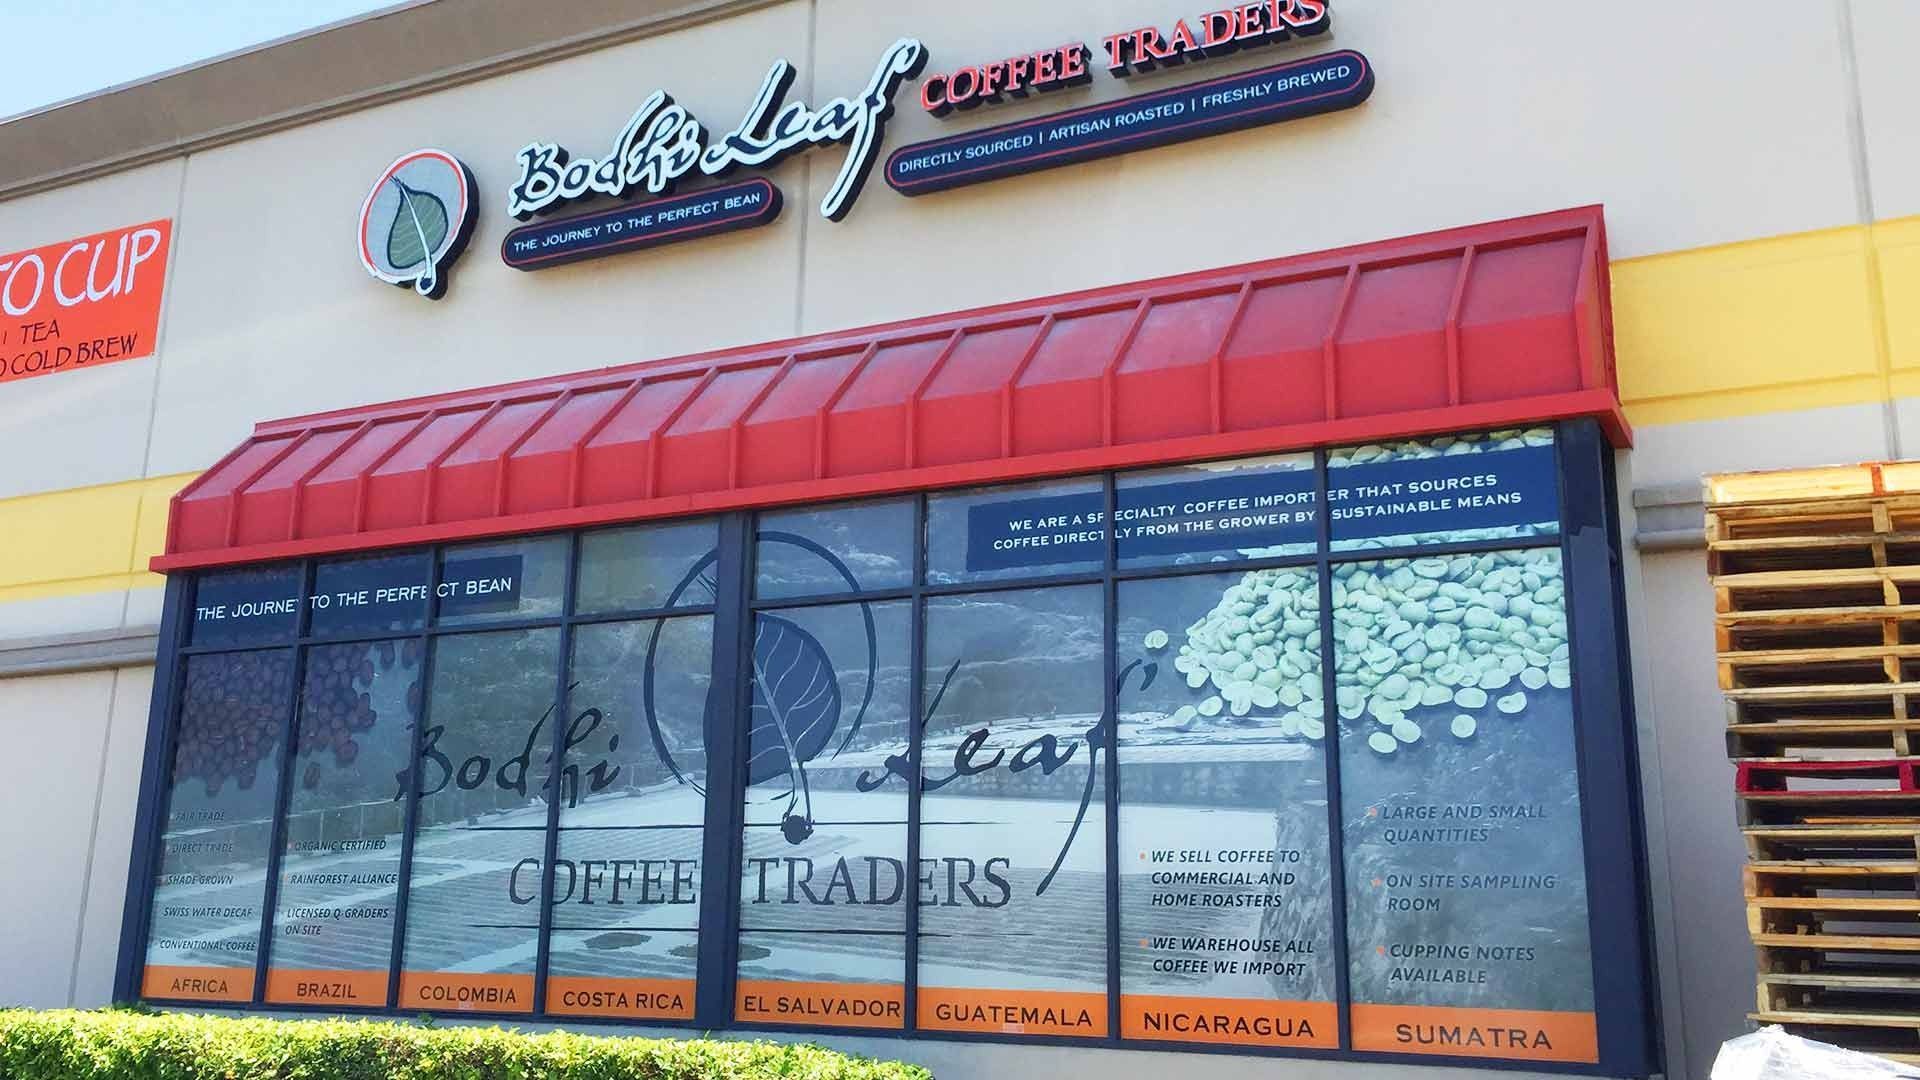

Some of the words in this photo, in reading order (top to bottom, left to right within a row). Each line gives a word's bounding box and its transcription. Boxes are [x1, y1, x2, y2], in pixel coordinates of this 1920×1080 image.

[920, 42, 1086, 111] COFFEE
[1104, 0, 1327, 70] TRADERS
[508, 89, 701, 217] Bodhi
[700, 37, 921, 217] Leaf
[899, 151, 963, 173] DIRECTLY
[965, 136, 1033, 159] SOURCED
[1049, 117, 1111, 141] ARTISAN
[1114, 102, 1185, 126] ROASTED
[1202, 82, 1273, 108] FRESHLY
[1277, 64, 1351, 91] BREWED
[514, 238, 537, 252] THE
[542, 226, 601, 248] JOURNEY
[606, 222, 623, 234] TO
[628, 216, 652, 229] THE
[658, 203, 719, 223] PERFECT
[725, 192, 761, 210] BEAN
[54, 228, 161, 306] CUP
[20, 319, 60, 345] TEA
[11, 347, 71, 375] COLD
[76, 333, 138, 363] BREW
[1009, 520, 1033, 531] WE
[1037, 516, 1067, 529] ARE
[1072, 515, 1083, 525] A
[1183, 497, 1249, 514] COFFEE
[1254, 488, 1349, 507] IMPORTER
[1356, 483, 1402, 498] THAT
[1408, 474, 1497, 493] SOURCES
[993, 535, 1050, 550] COFFEE
[1054, 525, 1132, 544] DIRECTLY
[1137, 522, 1179, 536] FROM
[1184, 519, 1214, 532] THE
[1219, 513, 1289, 529] GROWER
[1295, 510, 1315, 523] BY
[1331, 498, 1452, 519] SUSTAINABLE
[1458, 492, 1522, 508] MEANS
[197, 605, 226, 620] THE
[232, 598, 299, 618] JOURNE
[309, 594, 330, 609] TO
[337, 591, 369, 608] THE
[466, 577, 512, 595] BEAN
[1383, 806, 1437, 820] LARGE
[1442, 806, 1482, 819] AND
[1489, 805, 1548, 819] SMALL
[295, 840, 338, 851] ORGANIC
[340, 839, 386, 851] CERTIFIED
[1384, 828, 1489, 845] QUANTITIES
[1152, 850, 1174, 863] WE
[1179, 850, 1212, 863] SELL
[1218, 850, 1274, 863] COFFEE
[1280, 850, 1301, 863] TO
[168, 874, 198, 885] SHADE
[199, 874, 234, 885] GROWN
[291, 873, 349, 884] RAINFOREST
[350, 873, 397, 884] ALLIANCE
[509, 857, 698, 905] COFFEE
[747, 857, 1011, 908] TRADERS
[1151, 872, 1253, 885] COMMERCIAL
[1258, 872, 1295, 885] AND
[1386, 875, 1413, 888] ON
[1419, 875, 1456, 888] SITE
[1460, 875, 1556, 889] SAMPLING
[1152, 893, 1198, 906] HOME
[1202, 894, 1282, 907] ROASTERS
[1388, 898, 1440, 912] ROOM
[163, 906, 190, 917] SWISS
[192, 907, 221, 918] WATER
[223, 908, 253, 918] DECAF
[287, 908, 331, 918] LICENSED
[285, 925, 300, 935] ON
[301, 925, 322, 935] SITE
[160, 939, 224, 950] CONVENTIONAL
[226, 941, 256, 952] COFFEE
[1152, 937, 1177, 950] WE
[1182, 938, 1280, 952] WAREHOUSE
[1285, 940, 1314, 953] ALL
[1390, 944, 1470, 959] CUPPING
[1476, 947, 1535, 961] NOTES
[1153, 959, 1208, 973] COFFEE
[1214, 961, 1238, 974] WE
[1243, 961, 1306, 976] IMPORT
[1391, 967, 1487, 984] AVAILABLE
[171, 978, 228, 993] AFRICA
[297, 983, 356, 998] BRAZIL
[419, 985, 517, 1003] COLOMBIA
[563, 990, 629, 1008] COSTA
[635, 992, 684, 1010] RICA
[744, 996, 770, 1013] EL
[777, 996, 900, 1018] SALVADOR
[936, 1003, 1092, 1027] GUATEMALA
[1144, 1012, 1314, 1038] NICARAGUA
[1396, 1023, 1553, 1050] SUMATRA
